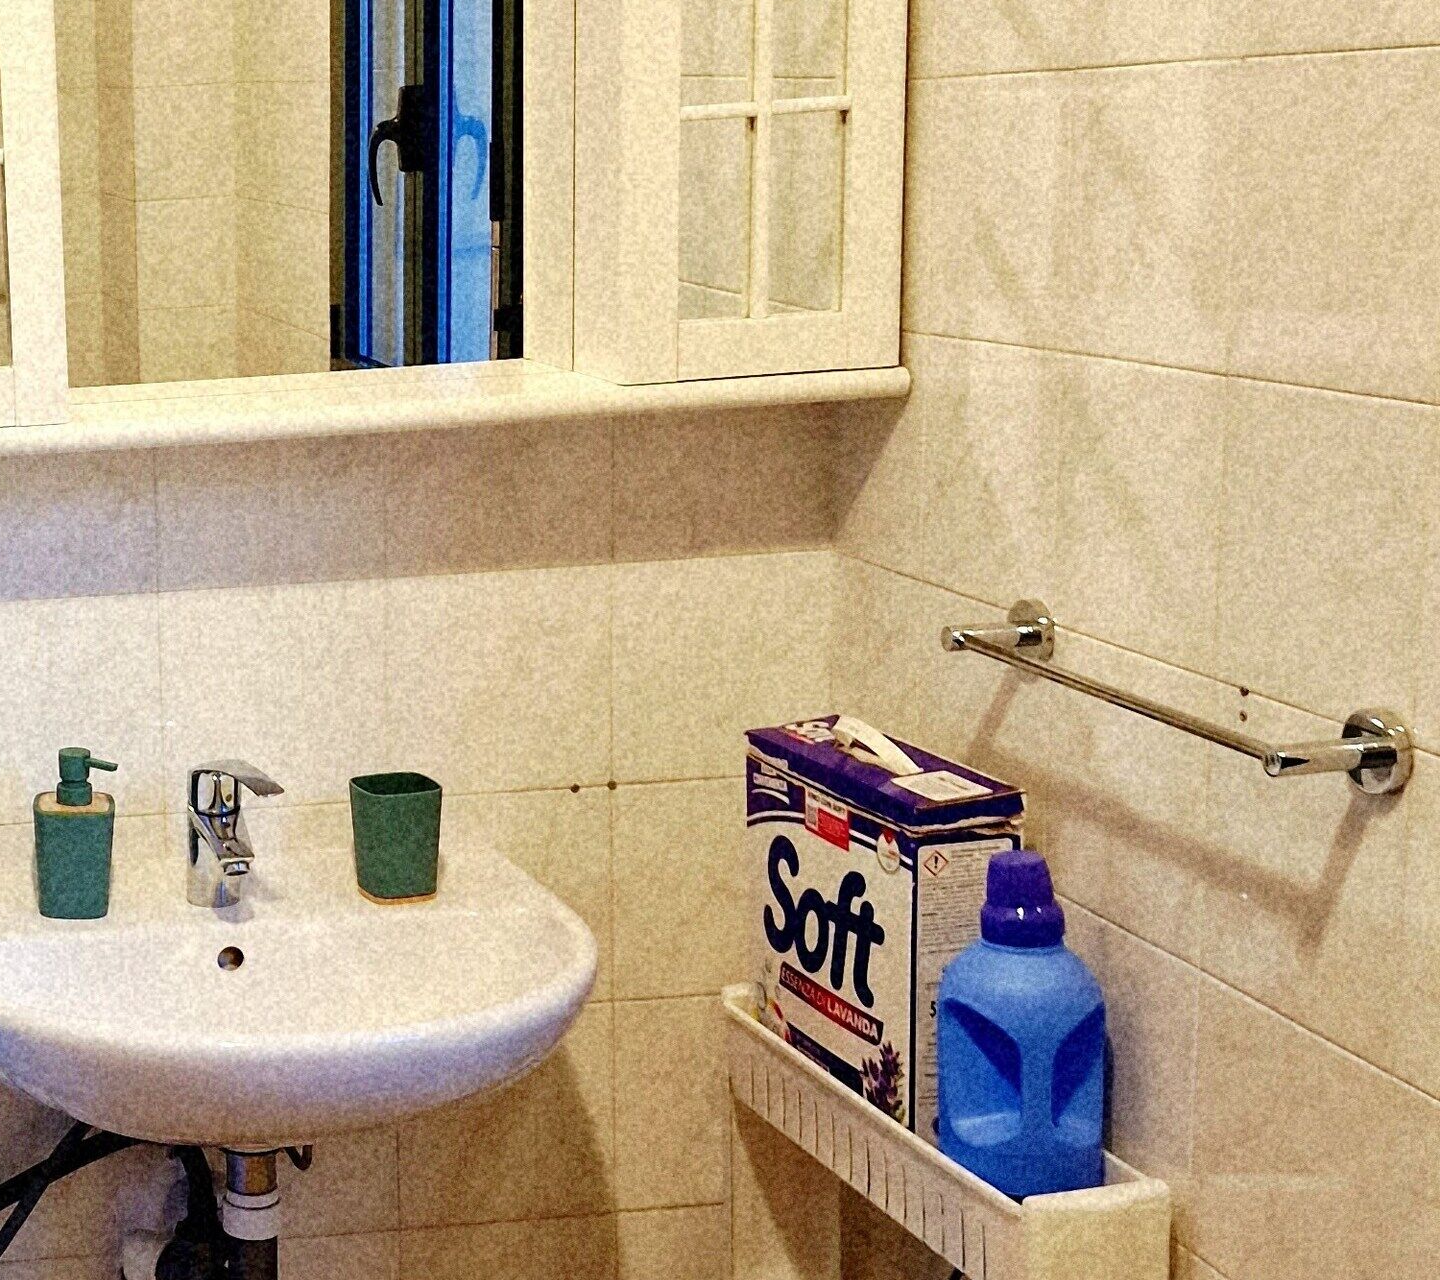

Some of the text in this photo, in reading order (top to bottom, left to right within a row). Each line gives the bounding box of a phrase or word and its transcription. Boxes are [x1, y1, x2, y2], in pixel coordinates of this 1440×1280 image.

[762, 834, 885, 1009] Soft
[780, 966, 816, 1002] ESSENZA
[826, 999, 879, 1041] LAVANDA
